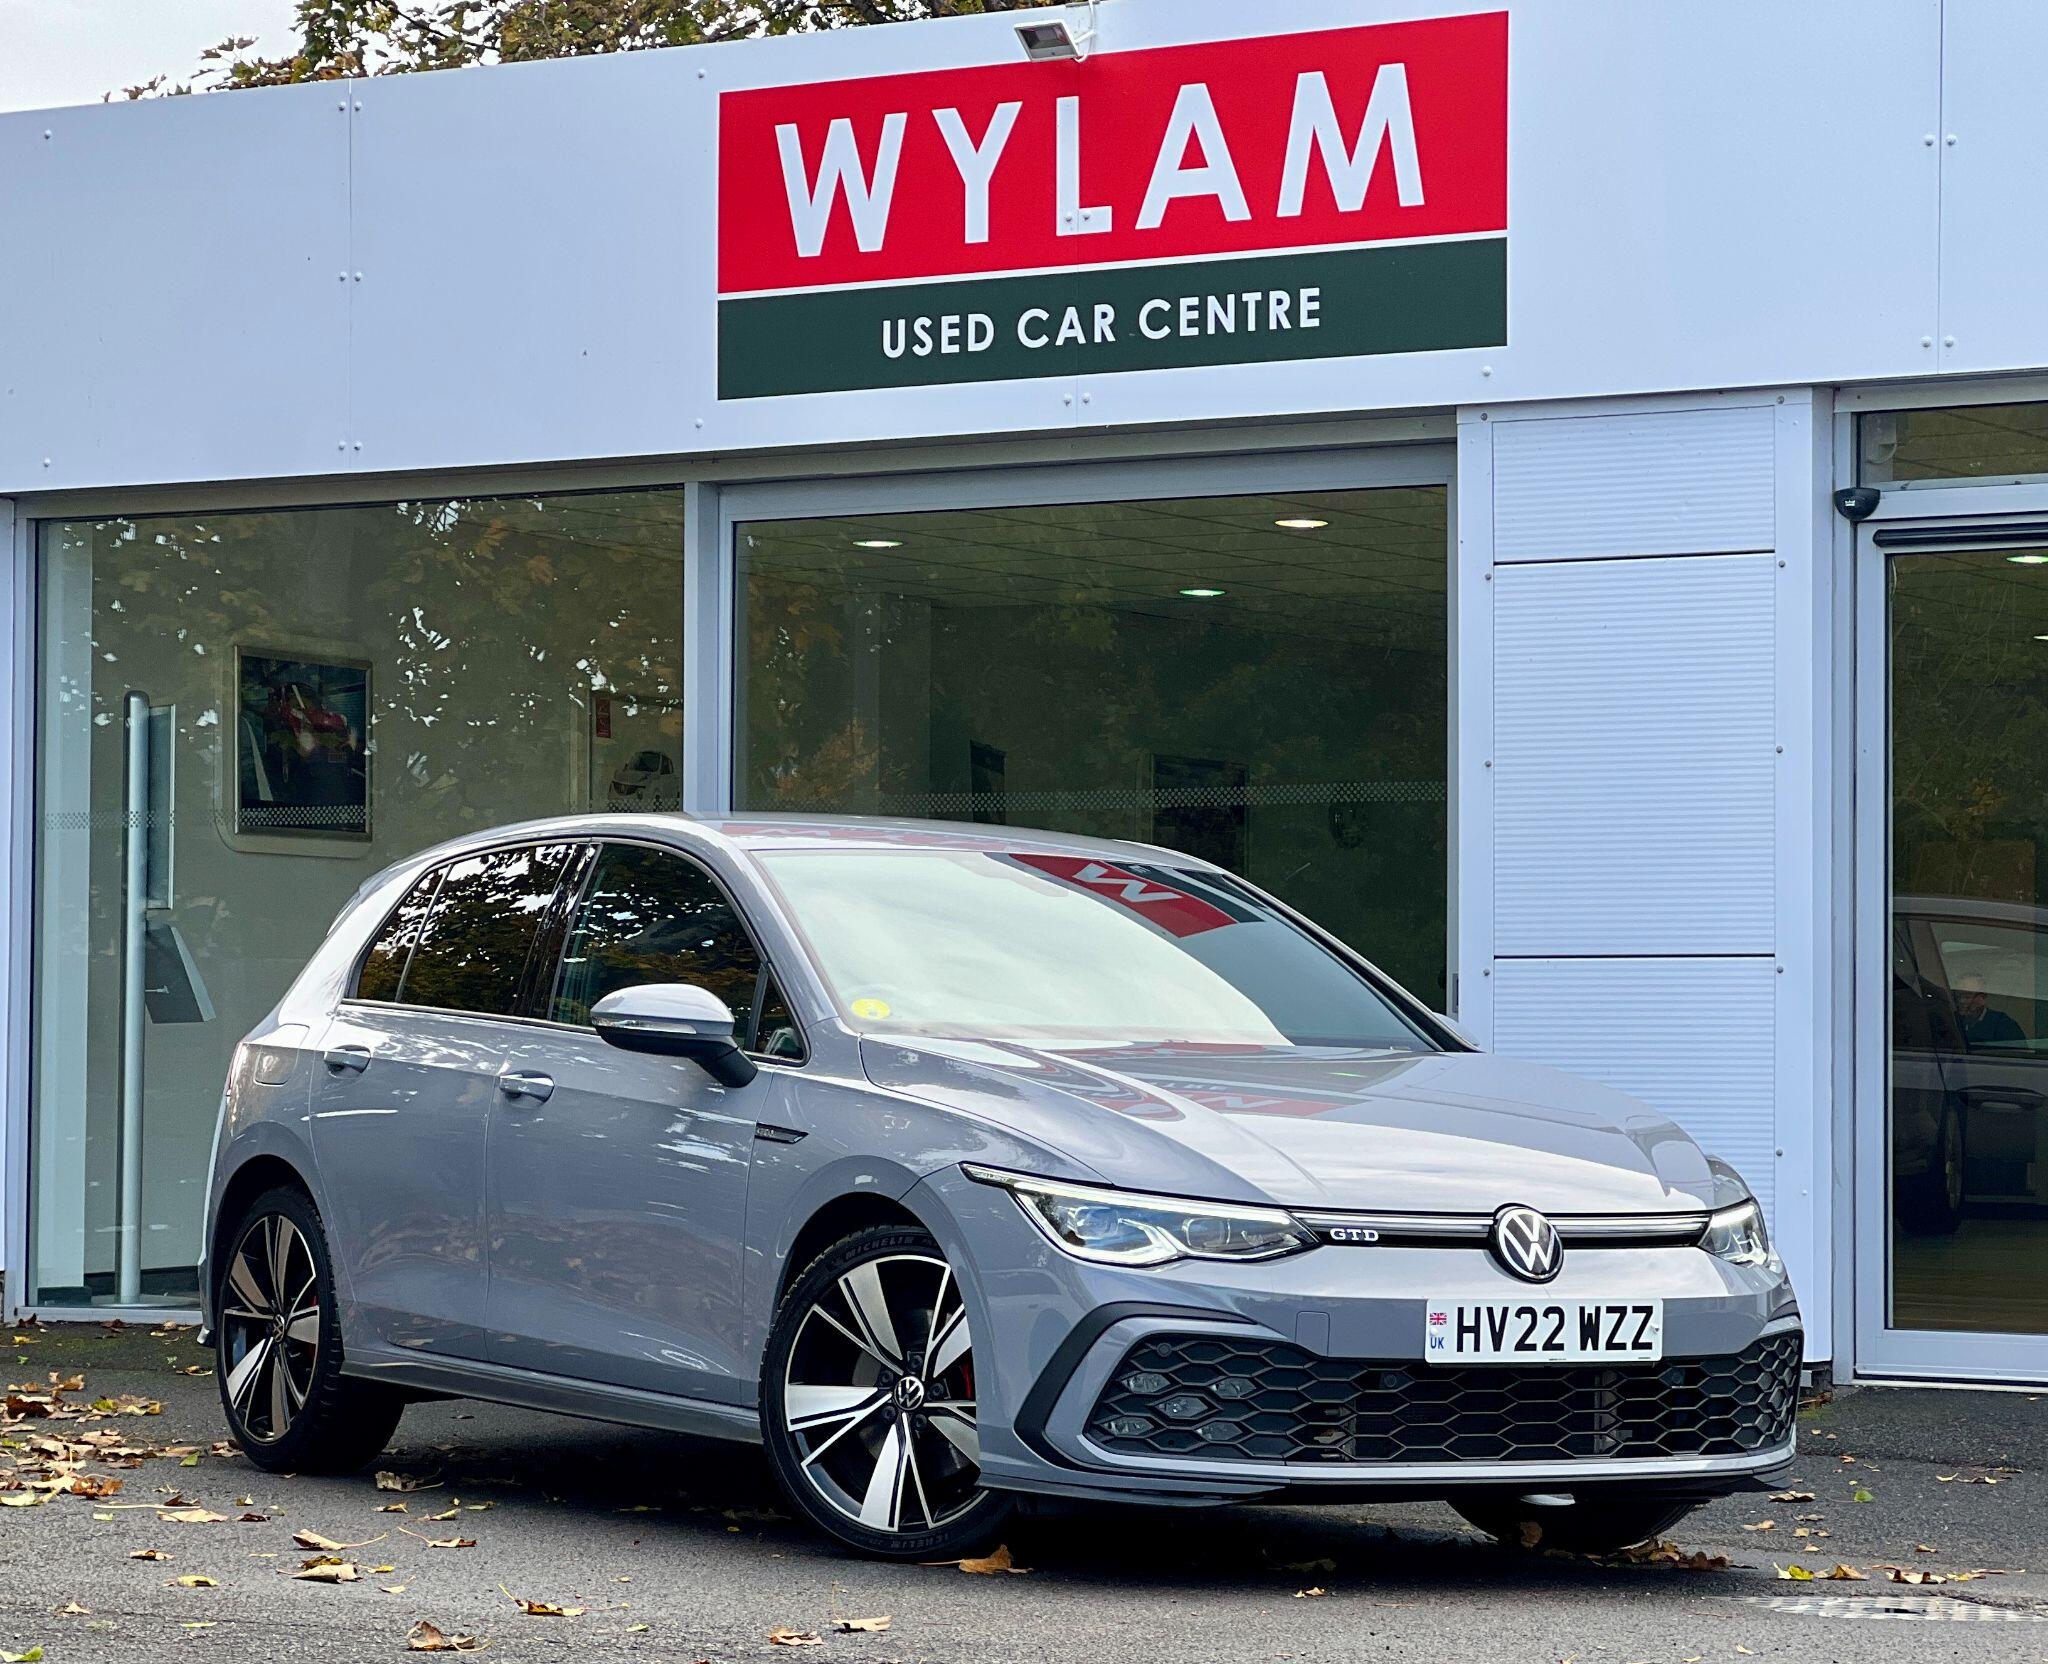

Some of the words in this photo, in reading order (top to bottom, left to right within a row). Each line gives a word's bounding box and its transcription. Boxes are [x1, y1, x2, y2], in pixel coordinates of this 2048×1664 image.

[774, 63, 1426, 258] WYLAM
[882, 312, 994, 359] USED
[1017, 302, 1116, 349] CAR
[1138, 287, 1320, 340] CENTRE
[845, 1236, 915, 1260] MICHELIN
[1330, 1228, 1379, 1242] GTD
[1430, 1337, 1444, 1350] UK
[1456, 1306, 1565, 1353] HV22
[1578, 1305, 1653, 1351] WZZ
